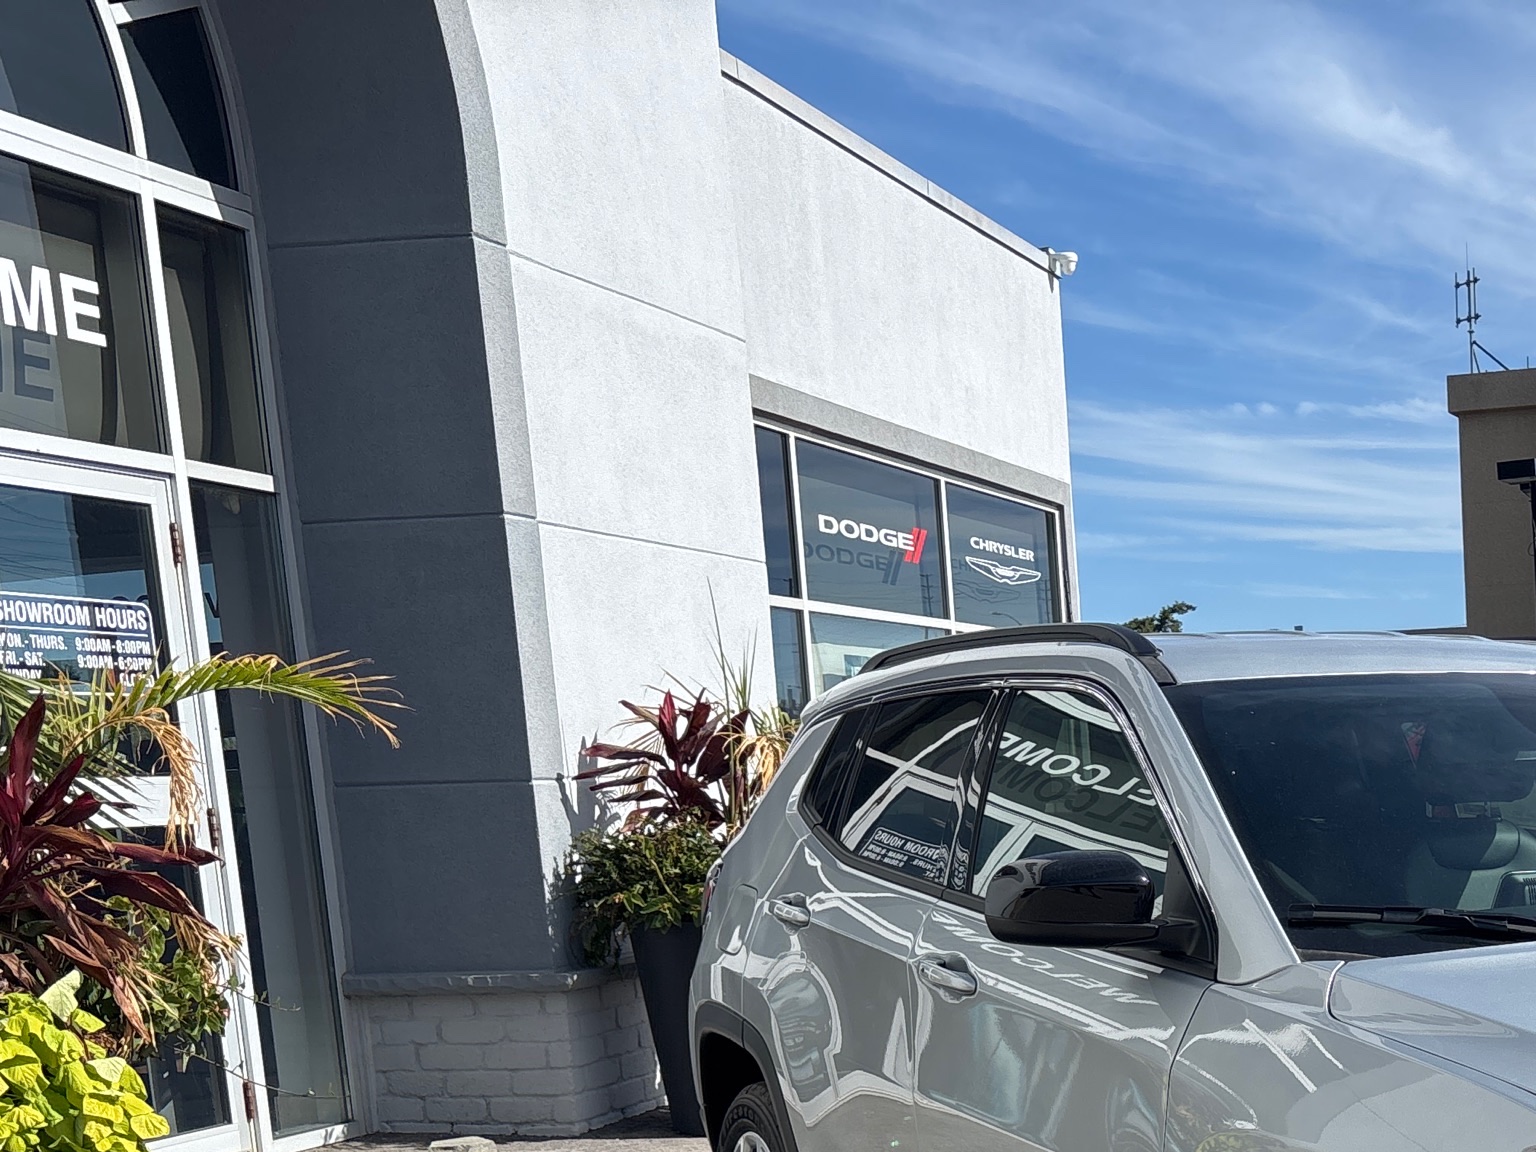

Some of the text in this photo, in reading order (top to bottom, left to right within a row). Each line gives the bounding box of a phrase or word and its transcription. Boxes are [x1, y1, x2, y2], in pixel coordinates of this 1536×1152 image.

[817, 513, 915, 552] DODGE
[969, 536, 1035, 562] CHRYSLER
[95, 607, 148, 631] HOURS
